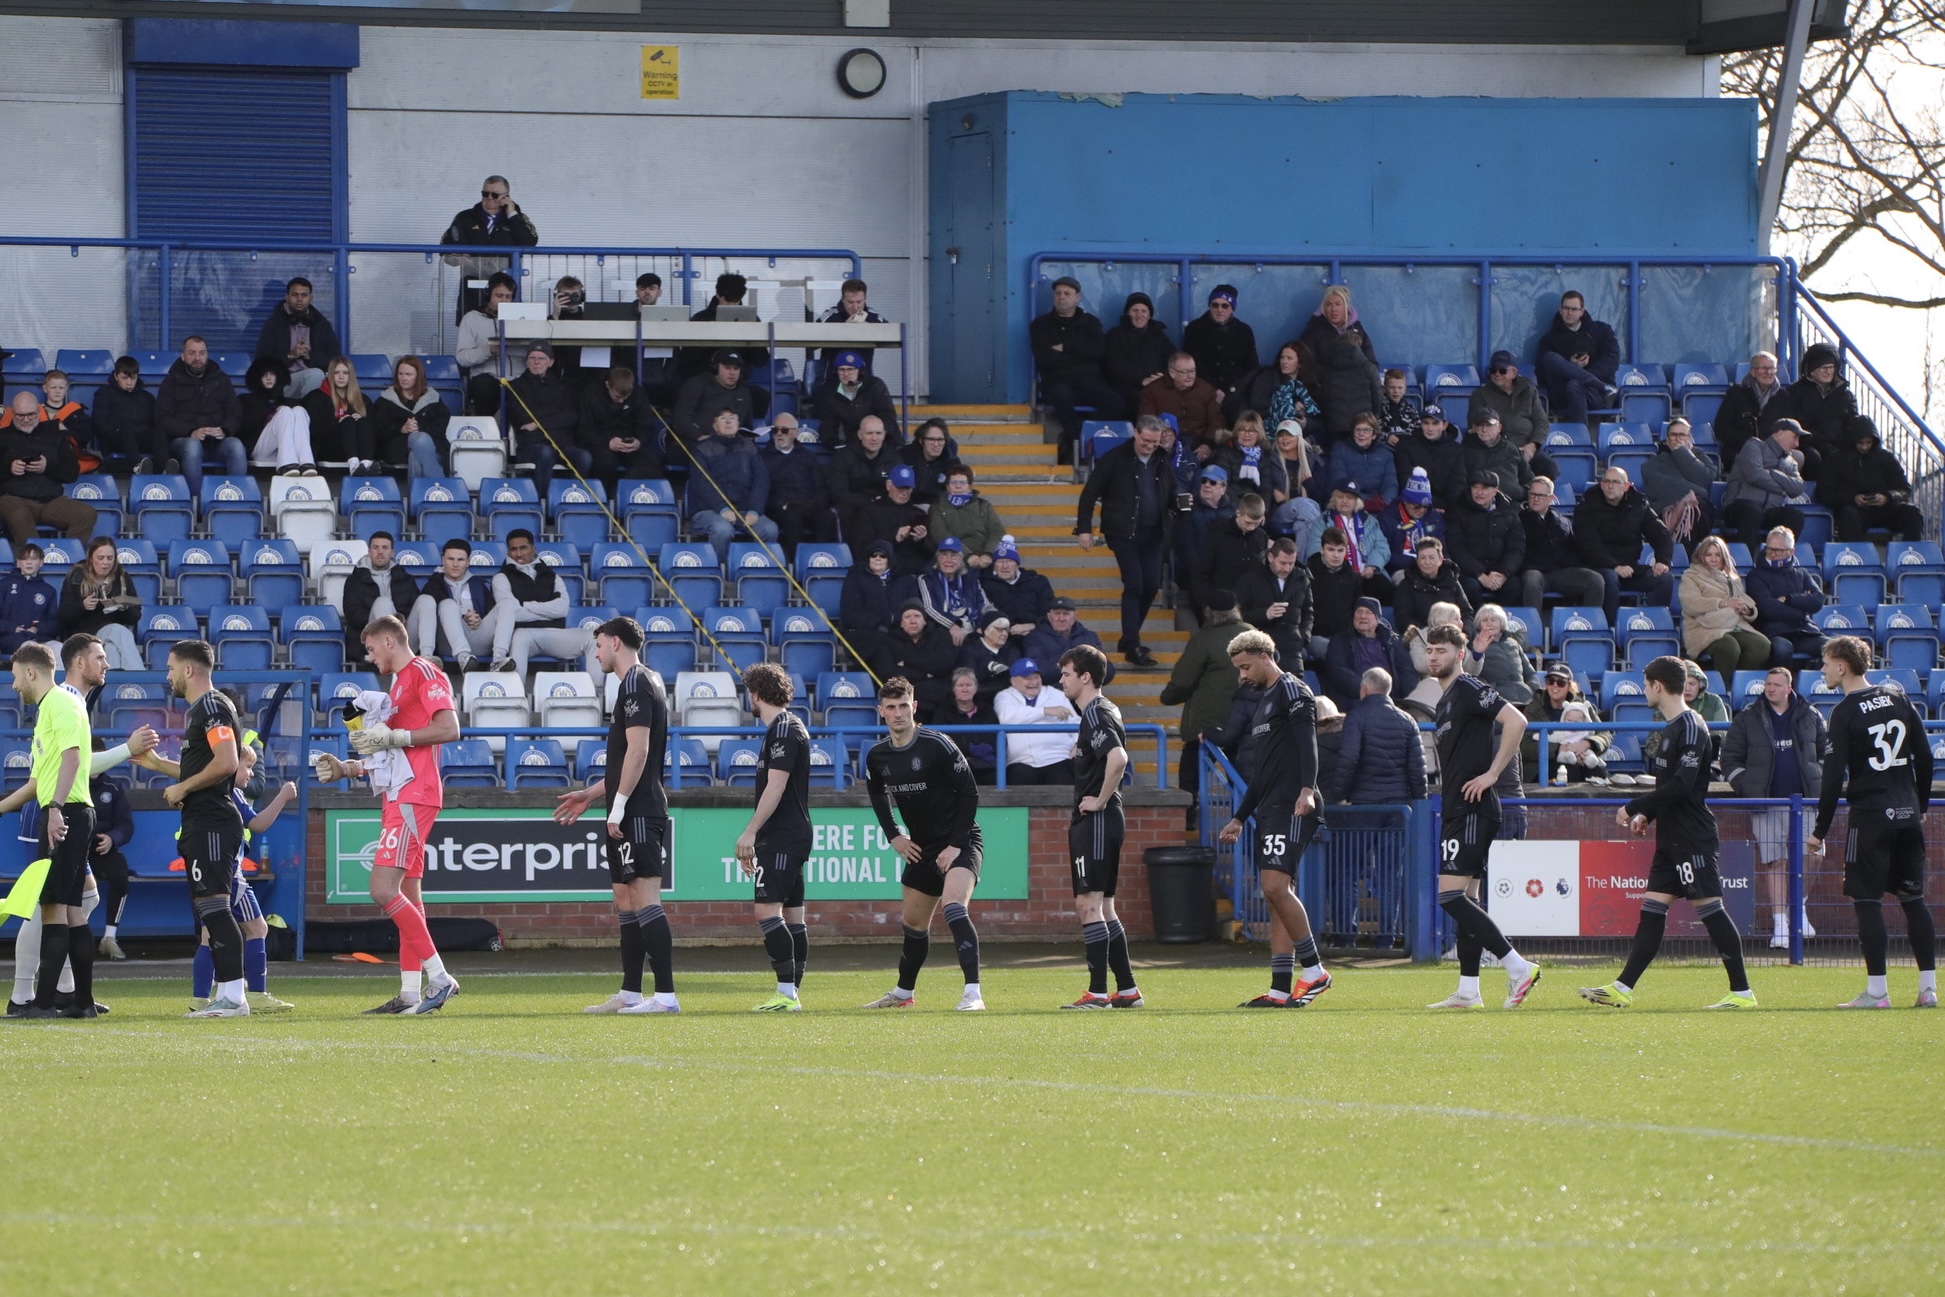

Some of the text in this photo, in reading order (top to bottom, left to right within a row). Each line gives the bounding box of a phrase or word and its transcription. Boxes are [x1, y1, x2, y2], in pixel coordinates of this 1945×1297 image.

[643, 71, 677, 81] Warning
[1859, 695, 1894, 714] PASIEK
[1867, 719, 1907, 771] 32
[377, 827, 398, 849] 26
[812, 824, 855, 851] ERE
[1263, 834, 1286, 856] 35
[618, 841, 635, 866] 12
[1441, 838, 1459, 861] 19
[191, 859, 202, 882] 6
[721, 856, 758, 883] TH
[806, 856, 887, 883] TIONAL
[1075, 855, 1086, 878] 11
[1675, 861, 1694, 885] 28
[1585, 875, 1608, 889] The
[1610, 875, 1649, 889] Natio
[1625, 892, 1646, 900] Suppo
